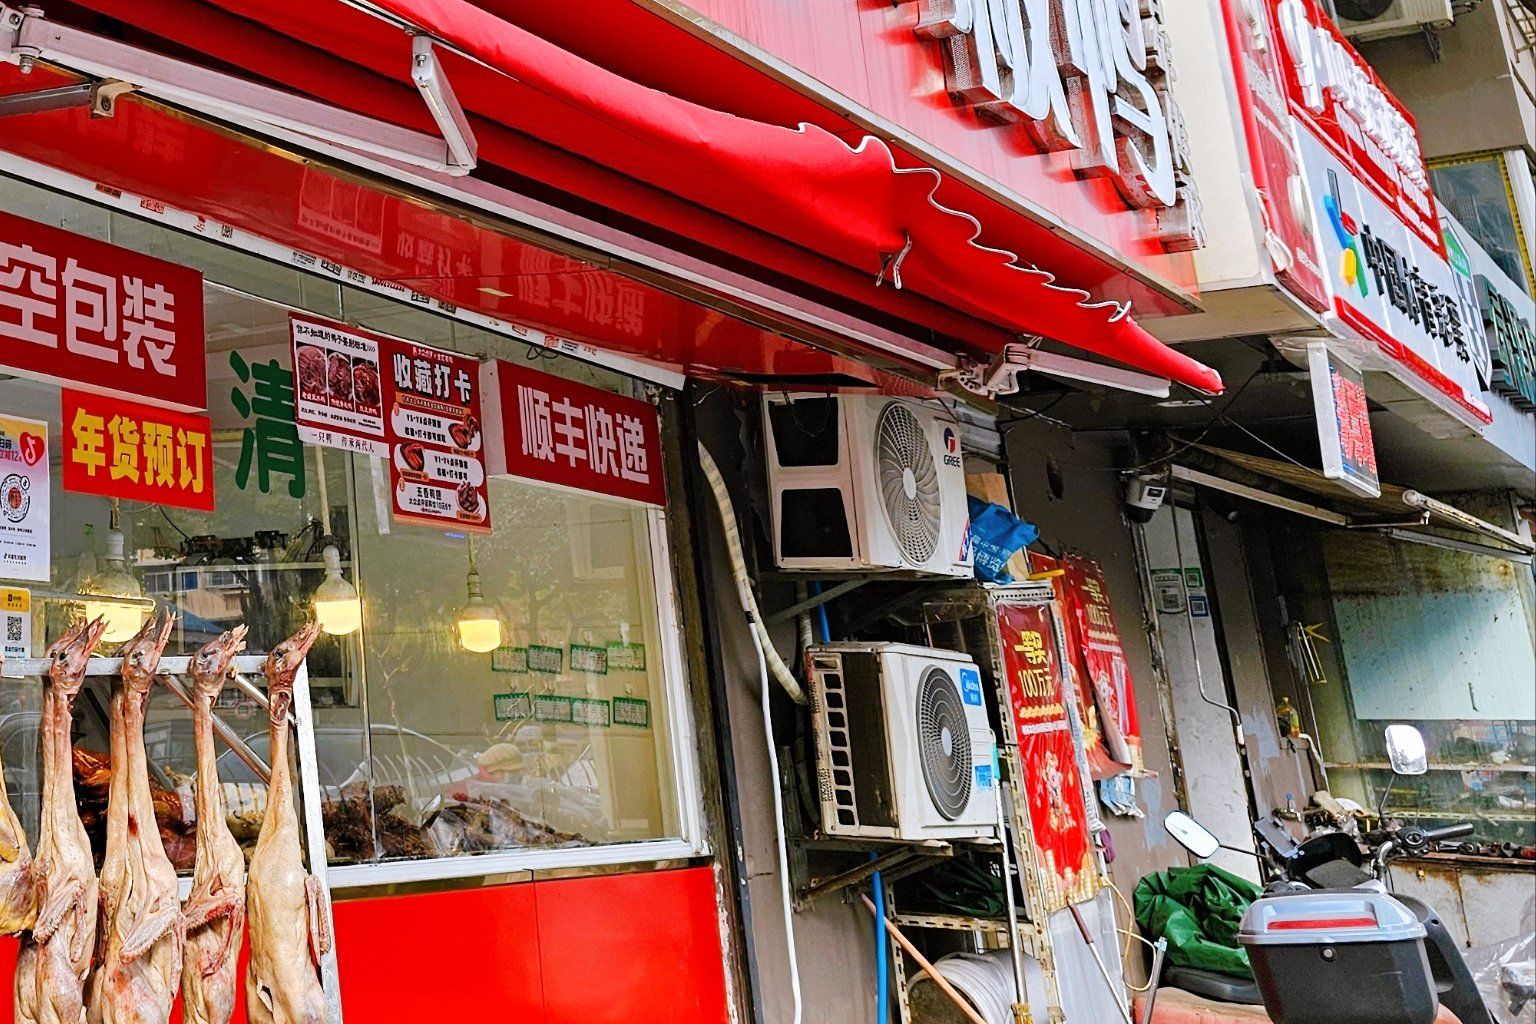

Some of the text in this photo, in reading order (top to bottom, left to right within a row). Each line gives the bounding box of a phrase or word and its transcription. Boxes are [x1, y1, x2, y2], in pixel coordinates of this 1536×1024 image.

[1360, 224, 1470, 364] 中国体育彩票
[393, 353, 472, 404] 收藏打卡
[71, 407, 207, 493] 年货预订
[230, 350, 305, 499] 清
[517, 385, 651, 483] 顺丰快递
[943, 455, 960, 467] GREE
[1018, 667, 1055, 698] 100万元
